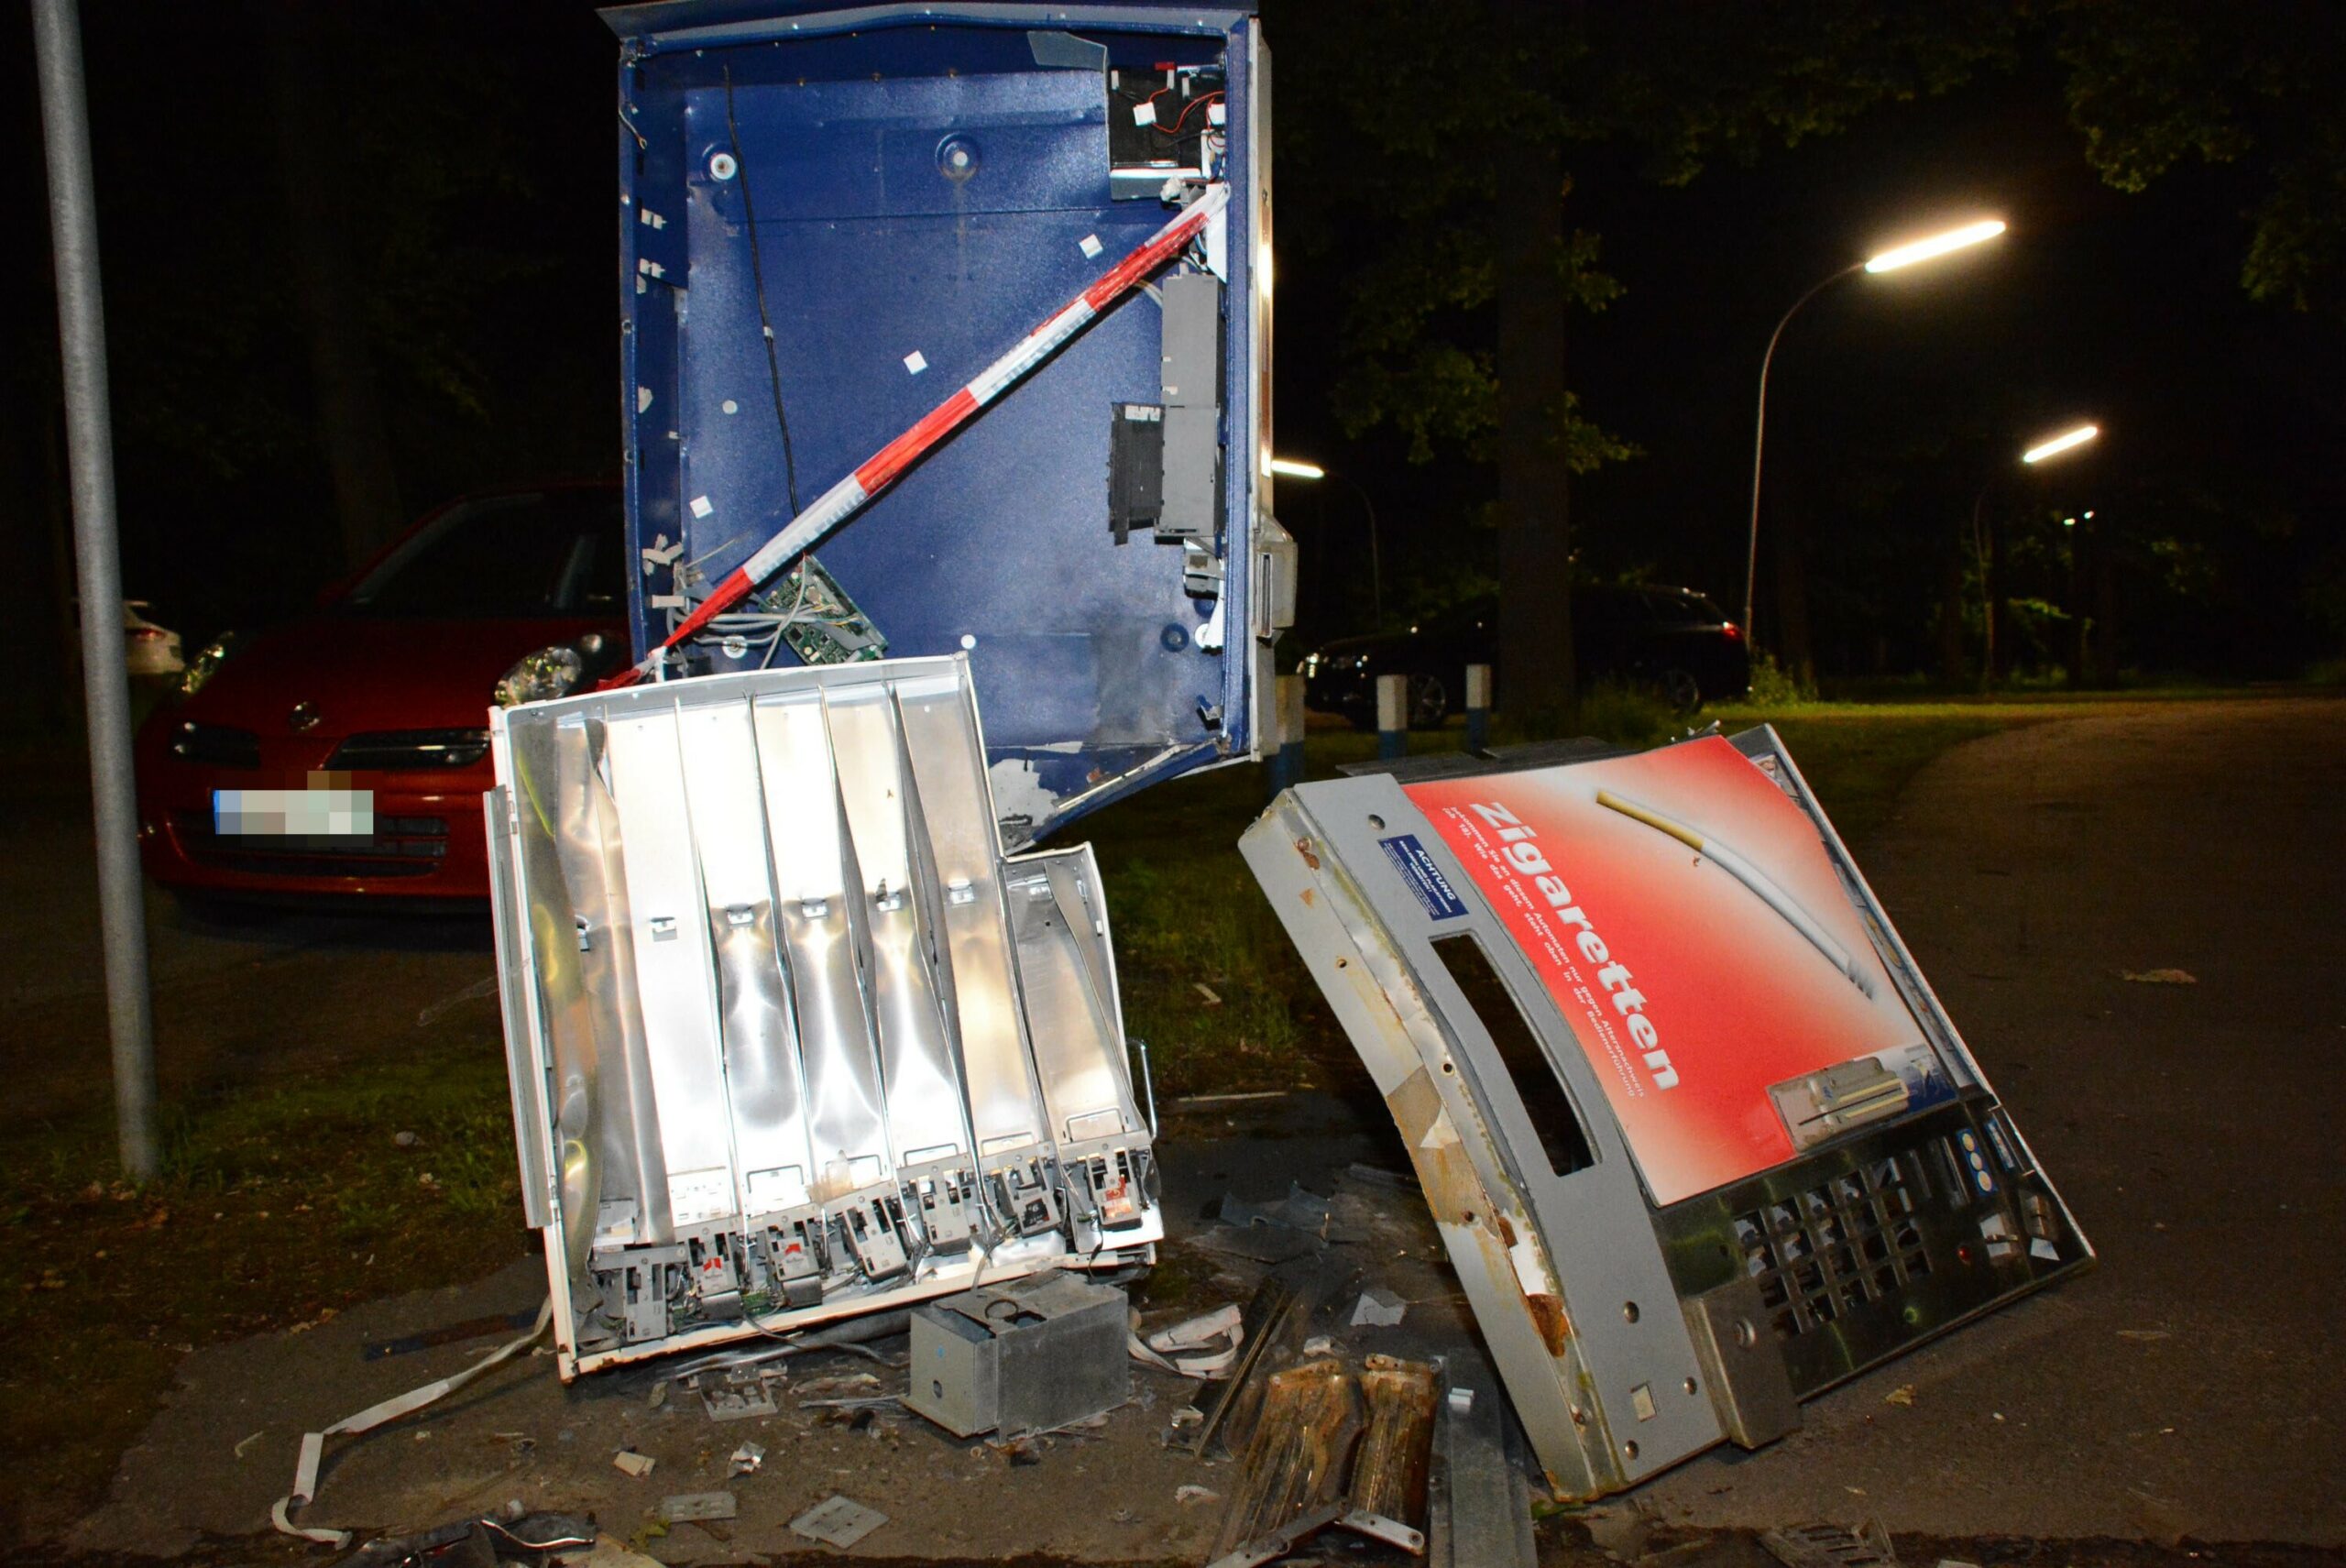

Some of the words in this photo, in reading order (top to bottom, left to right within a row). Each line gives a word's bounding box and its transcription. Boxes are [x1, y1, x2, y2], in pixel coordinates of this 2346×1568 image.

[1415, 849, 1456, 901] ACHTUNG
[1450, 806, 1489, 848] bekommen
[1488, 849, 1501, 863] Sie
[1499, 864, 1511, 877] an
[1509, 878, 1535, 910] diesem
[1533, 912, 1571, 964] Automaten
[1569, 965, 1584, 984] nur
[1580, 985, 1603, 1017] gegen
[1601, 1019, 1645, 1098] Altersnachweis
[1469, 802, 1680, 1091] Zigaretten
[1474, 842, 1488, 860] Wie
[1488, 863, 1503, 880] das
[1524, 912, 1544, 937] steht
[1543, 941, 1562, 967] oben
[1562, 970, 1573, 982] in
[1573, 987, 1587, 1005] der
[1586, 1010, 1636, 1098] Bedienerführung
